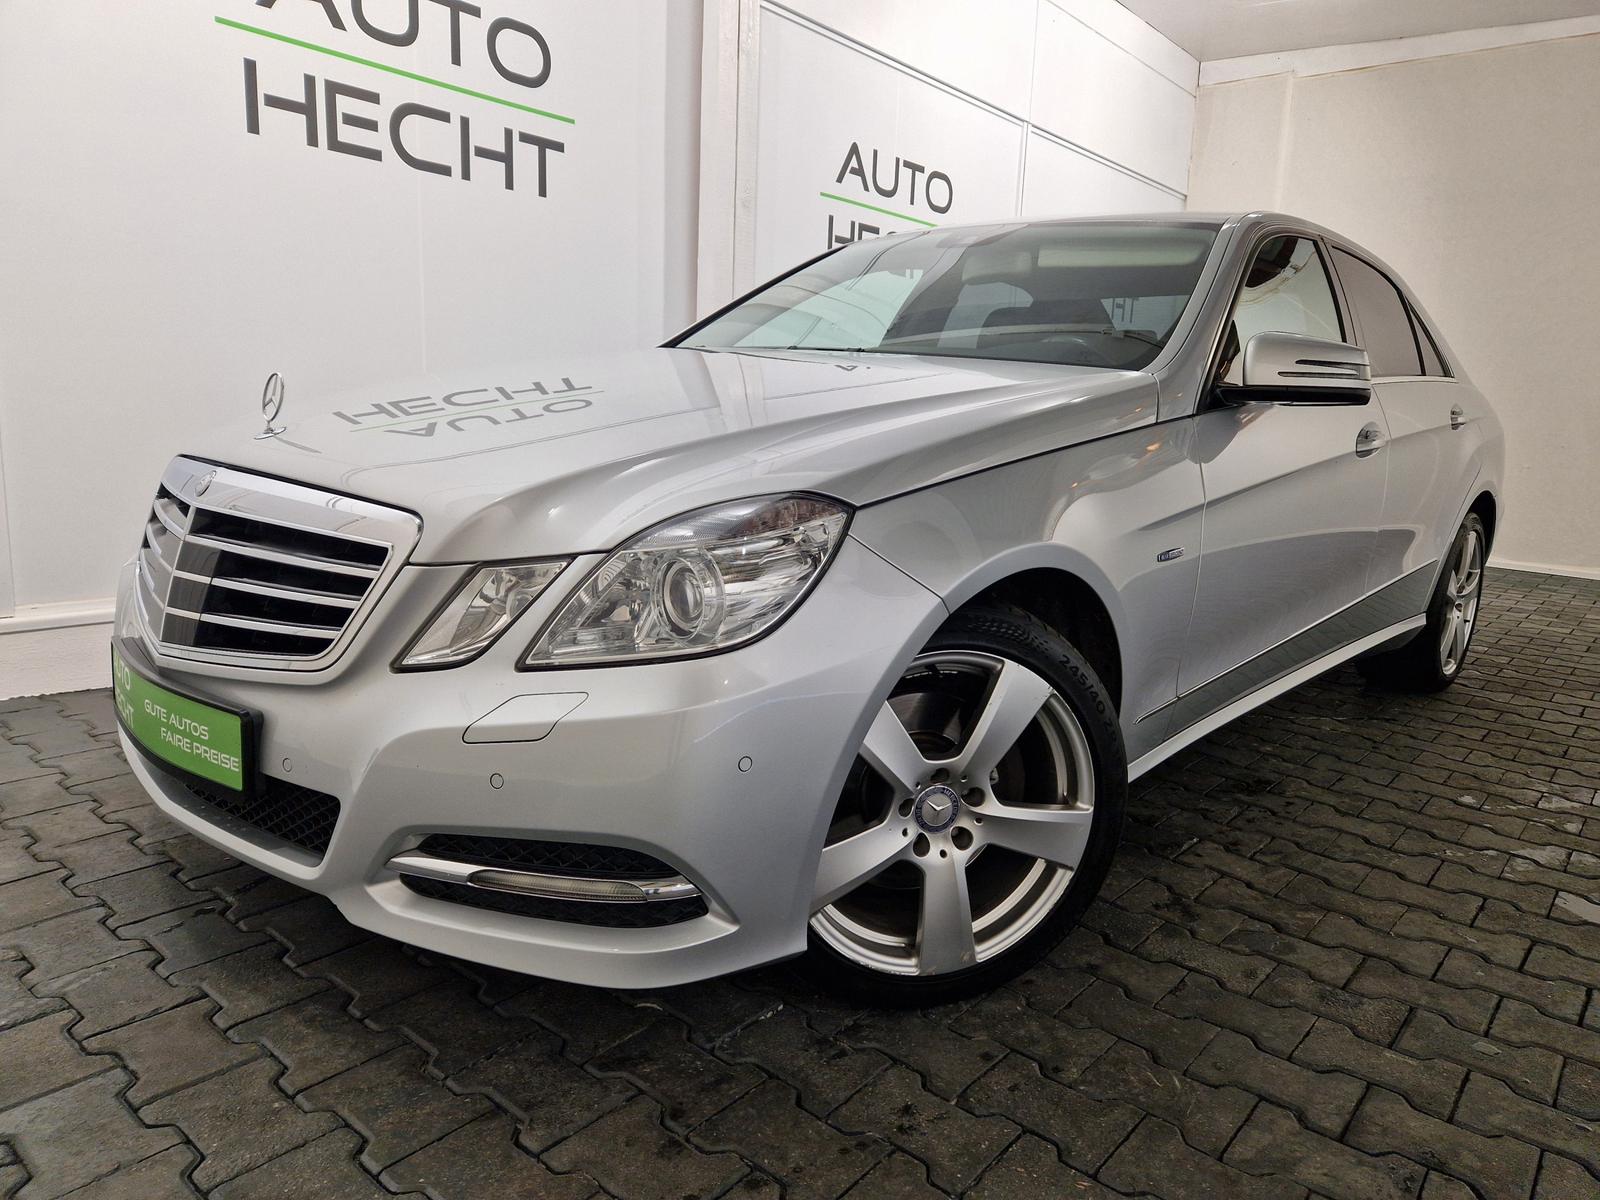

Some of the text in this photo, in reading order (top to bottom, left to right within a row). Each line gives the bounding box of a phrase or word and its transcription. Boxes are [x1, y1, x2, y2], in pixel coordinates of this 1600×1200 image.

[243, 57, 565, 198] HECHT
[835, 141, 953, 214] AUTO
[144, 699, 209, 740] GUTE AUTOS
[160, 728, 240, 772] FAIRE PREISE
